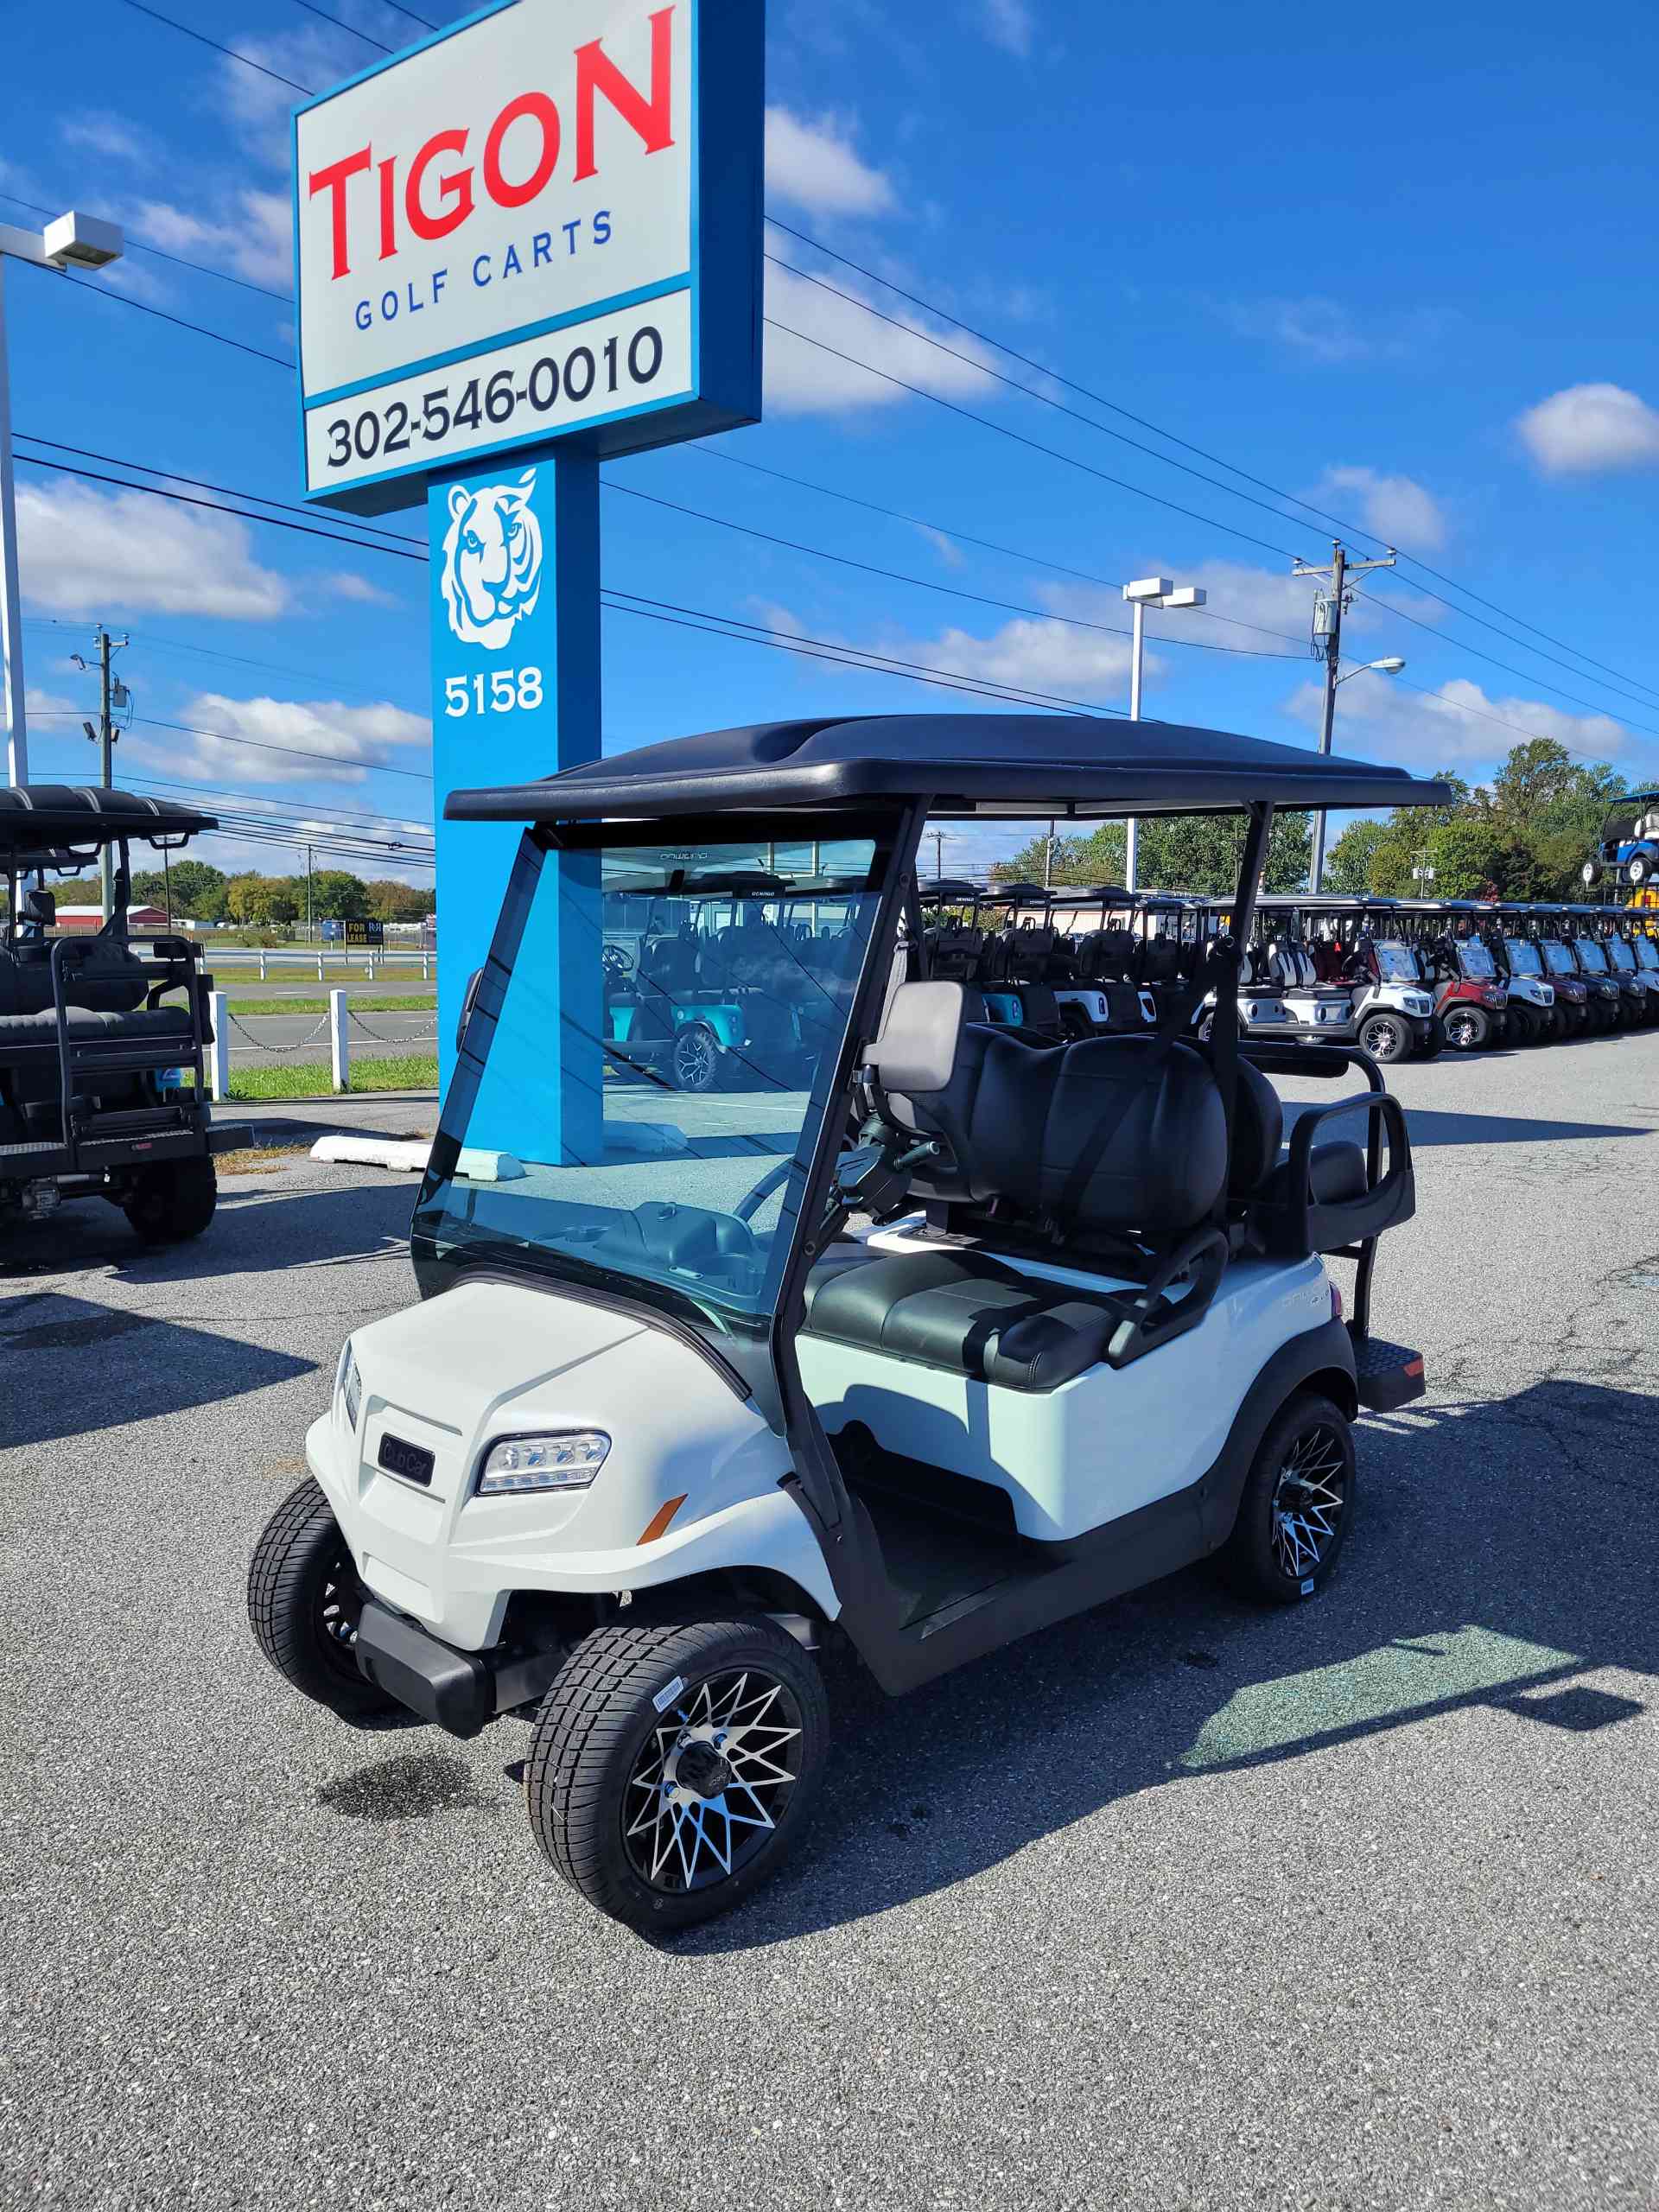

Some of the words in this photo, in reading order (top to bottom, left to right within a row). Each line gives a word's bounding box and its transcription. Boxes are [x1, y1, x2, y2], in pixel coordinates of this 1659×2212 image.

[309, 5, 676, 281] TIGON
[355, 270, 448, 331] GOLF
[473, 210, 613, 287] CARTS
[327, 326, 664, 467] 302-546-0010
[444, 666, 543, 717] 5158
[347, 933, 367, 943] LEASE
[348, 923, 365, 933] FOR
